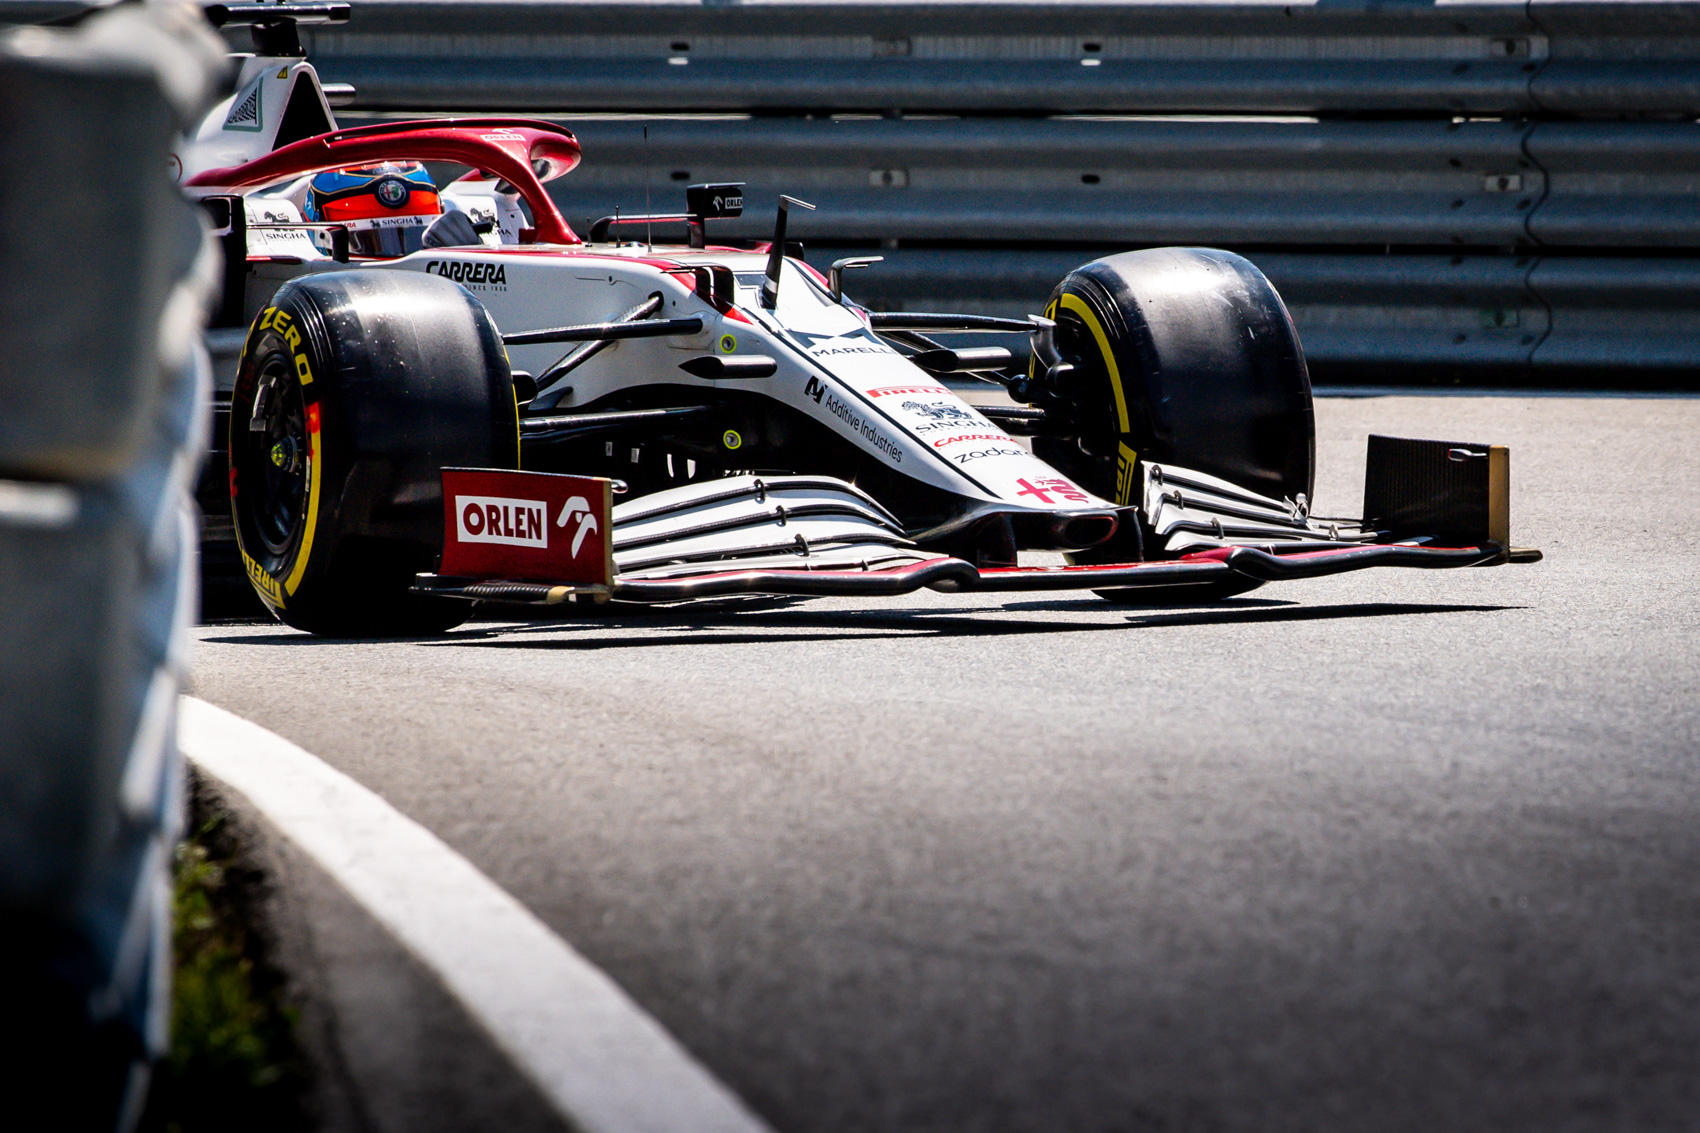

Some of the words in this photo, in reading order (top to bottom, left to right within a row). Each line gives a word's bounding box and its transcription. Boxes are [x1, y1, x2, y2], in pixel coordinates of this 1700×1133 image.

[381, 217, 415, 227] SINGHA
[265, 232, 307, 240] SINGHA
[425, 260, 507, 285] CARRERA
[258, 306, 314, 386] ZERO
[811, 347, 899, 357] MARELLI
[825, 394, 860, 431] Additive
[860, 419, 903, 464] Industries
[915, 420, 1001, 433] SINGHA
[954, 447, 1029, 464] zadar
[462, 502, 542, 541] ORLEN
